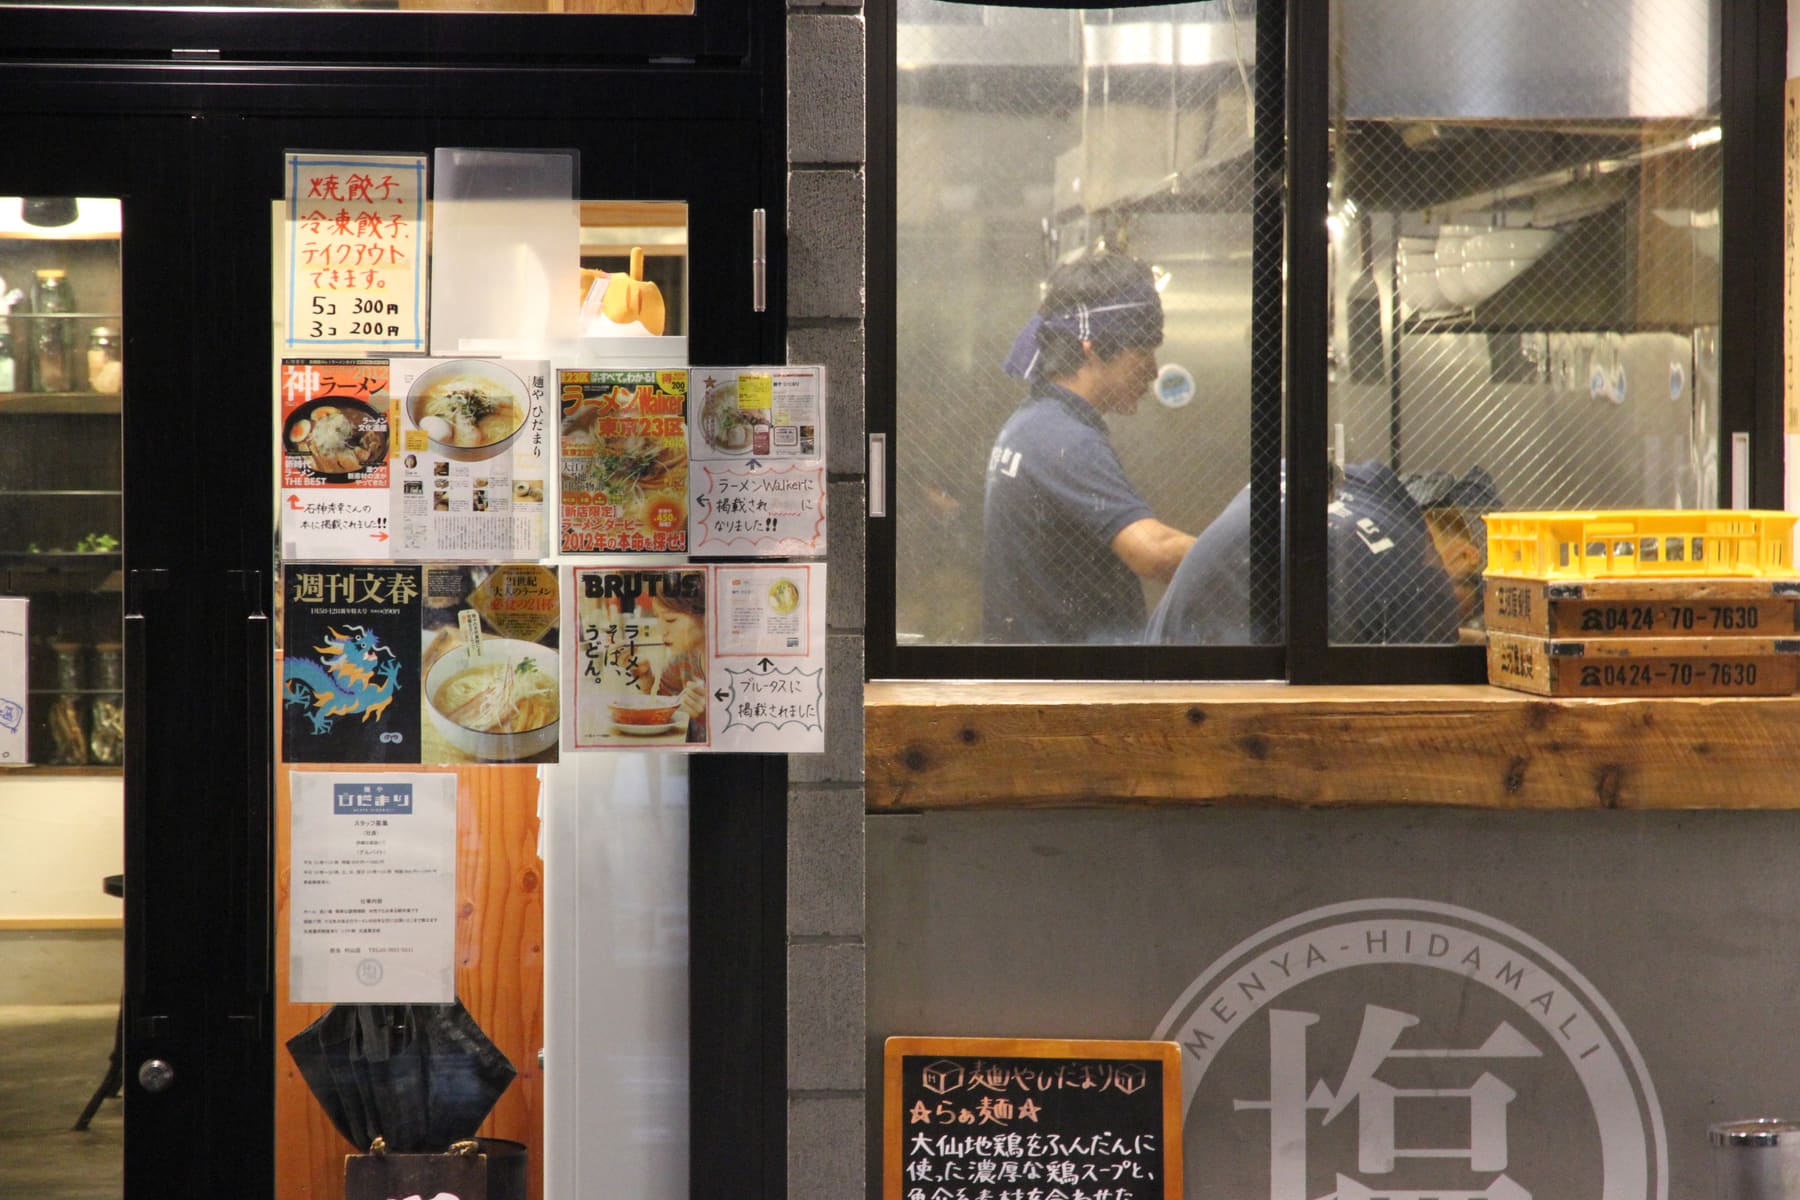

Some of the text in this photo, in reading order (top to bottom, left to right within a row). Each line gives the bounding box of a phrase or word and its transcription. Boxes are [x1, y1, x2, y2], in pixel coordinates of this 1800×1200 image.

[302, 242, 405, 266] テイクアウト
[309, 268, 385, 290] できます。
[352, 297, 399, 316] 300円
[350, 321, 399, 337] 200円
[598, 416, 685, 437] 東京23区
[293, 572, 419, 604] 週刊文春
[582, 573, 701, 613] BRUTUS
[1604, 663, 1757, 686] 0424-70-7630
